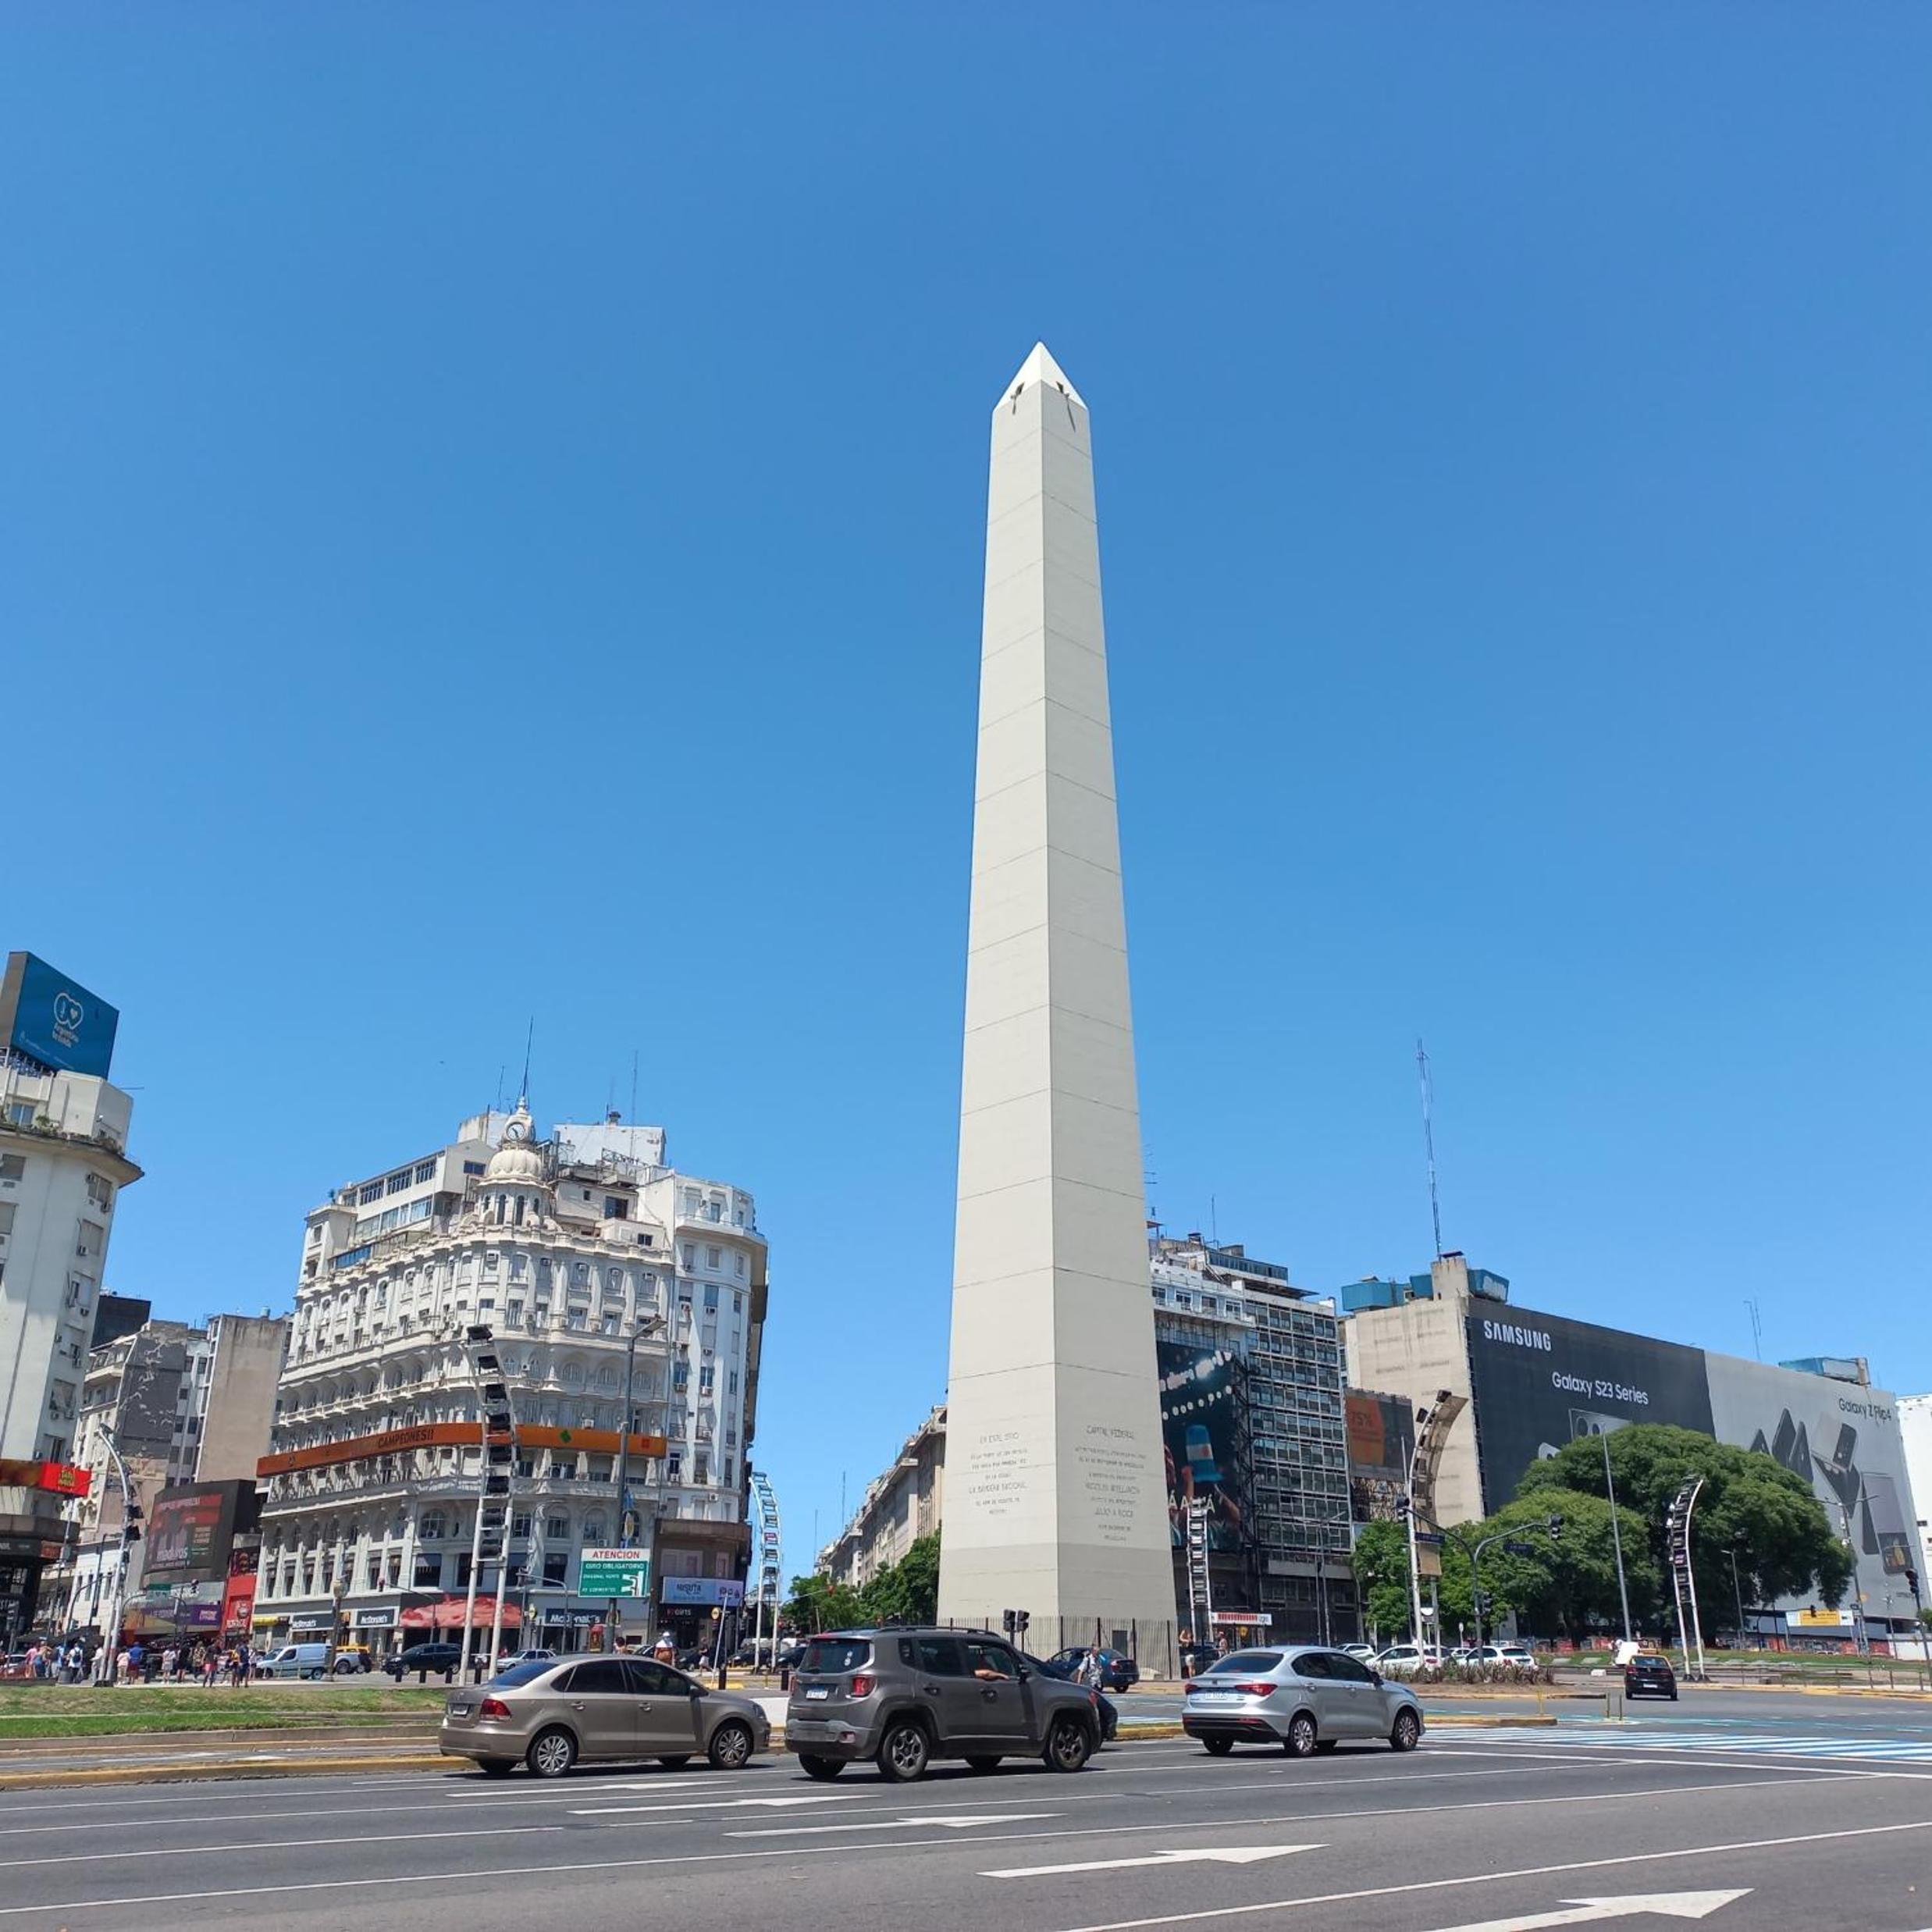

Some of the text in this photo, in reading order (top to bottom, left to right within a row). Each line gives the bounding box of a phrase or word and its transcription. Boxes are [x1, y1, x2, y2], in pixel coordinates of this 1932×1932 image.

[1484, 1319, 1552, 1352] SAMSUNG
[1552, 1371, 1649, 1405] Galaxy S23 Series
[1839, 1397, 1866, 1420] Galaxy
[592, 1550, 640, 1559] ATENCION
[360, 1614, 388, 1624] McDonald's
